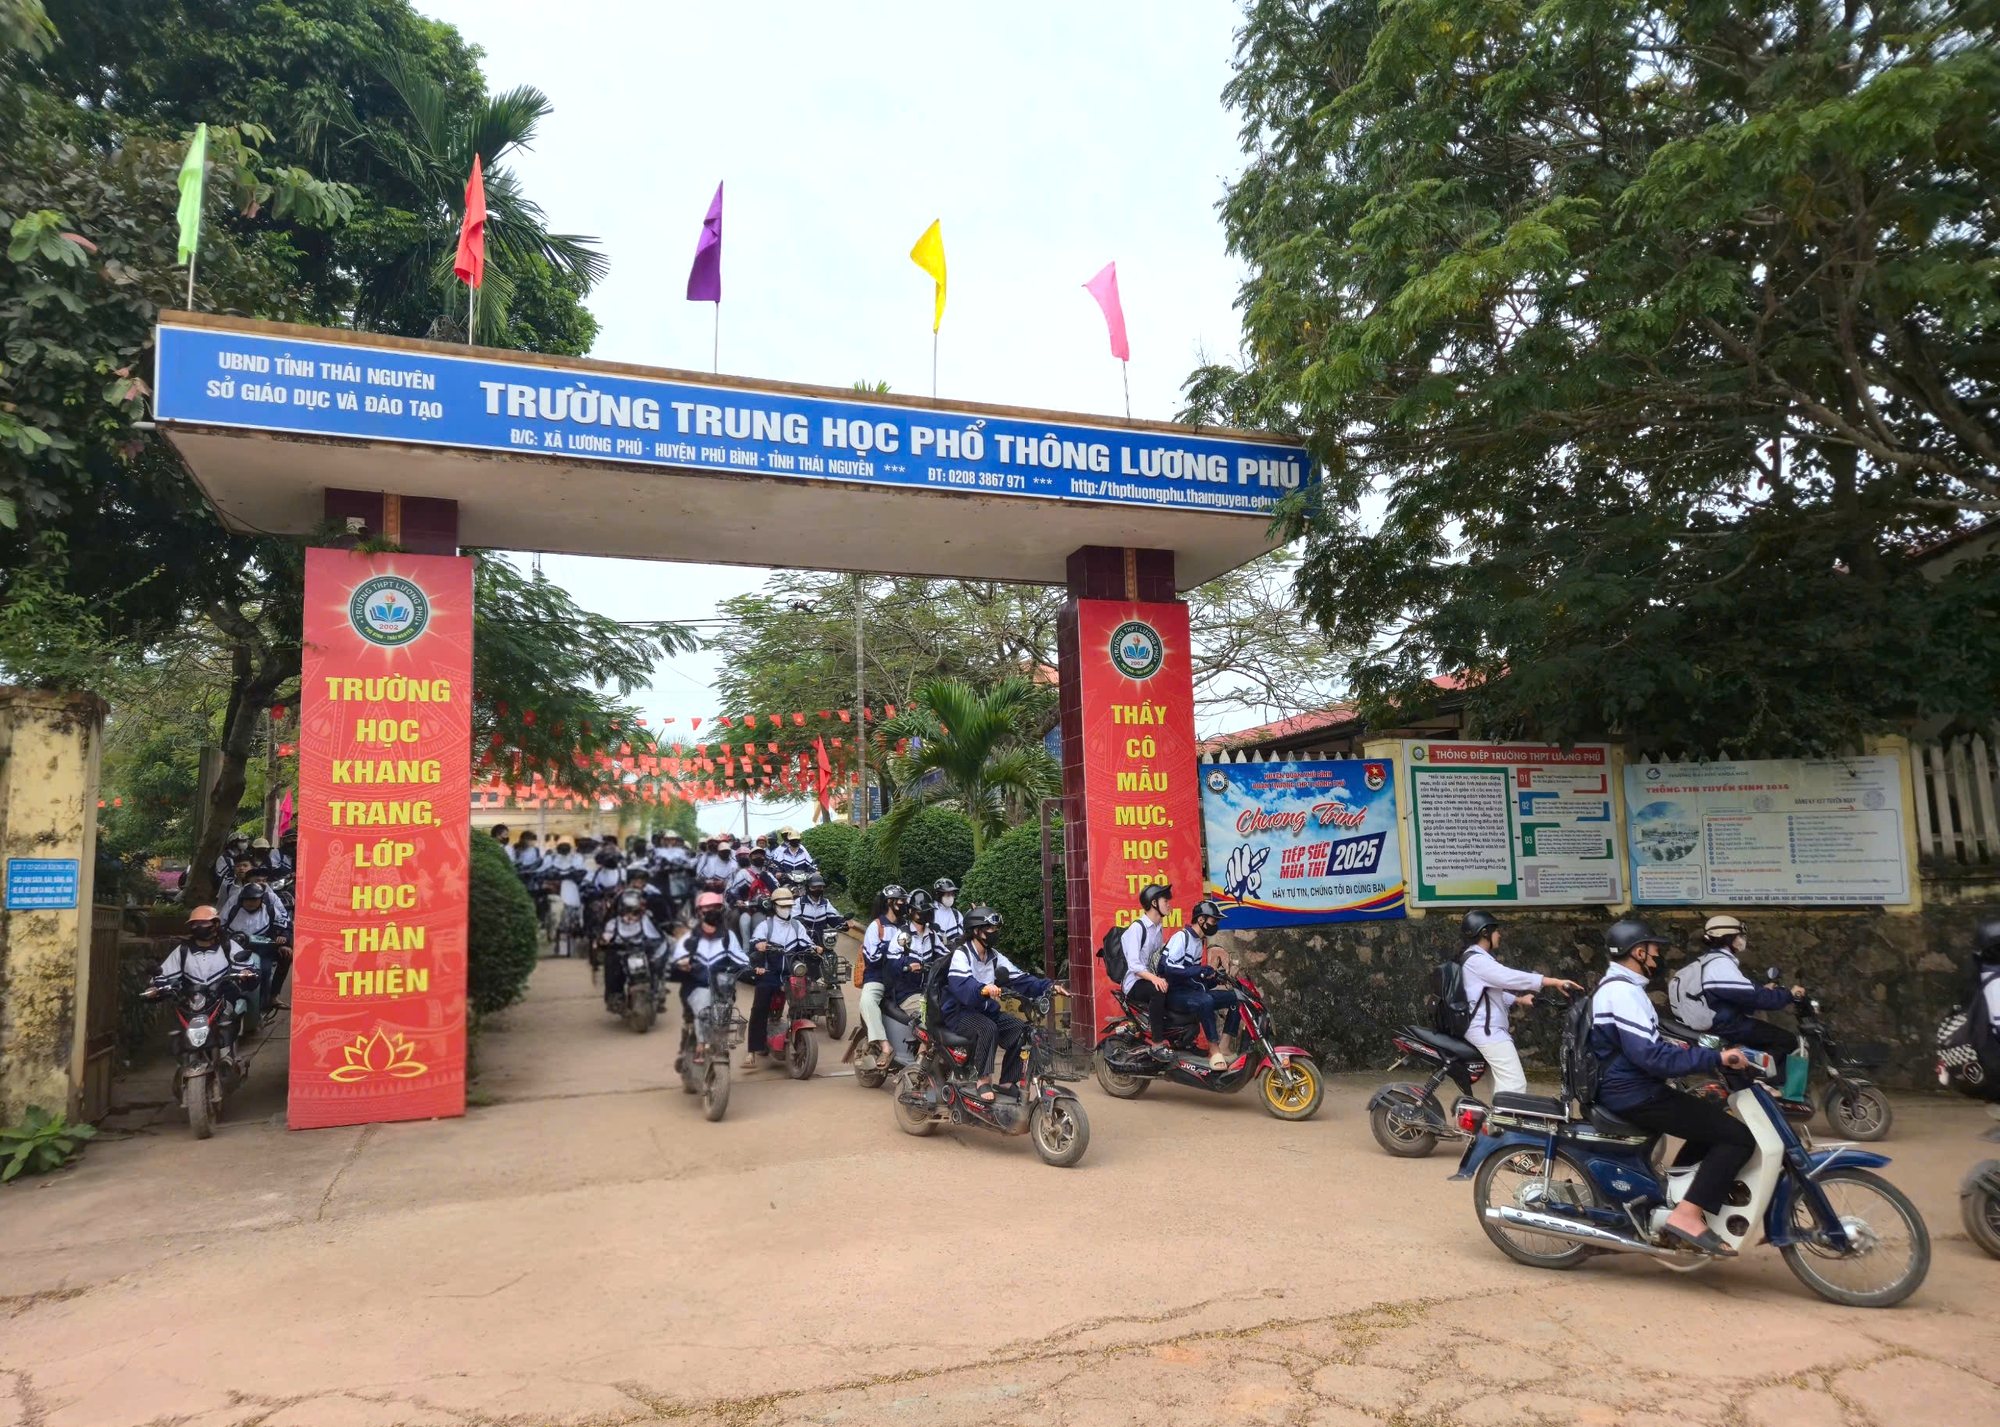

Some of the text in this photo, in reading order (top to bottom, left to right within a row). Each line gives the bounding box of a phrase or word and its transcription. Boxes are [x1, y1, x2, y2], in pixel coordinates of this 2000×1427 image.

[219, 351, 435, 391] UBND TỈNH THÁI NGUYÊN
[206, 375, 443, 421] SỞ GIÁO DỤC VÀ ĐÀO TẠO
[479, 380, 1299, 488] TRƯỜNG TRUNG HỌC PHỔ THÔNG LƯƠNG PHÚ
[509, 429, 1280, 510] Đ/C: XÃ LƯƠNG PHÚ HUYỆN PHÚ BÌNH TỈNH THÁI NGUYÊN ĐT: 0208 3867 971 http://thptluongphu.thainguyen.edu.v
[355, 581, 424, 622] TRƯỜNG THPT LƯƠNG PHÚ
[379, 623, 399, 631] 2002
[325, 673, 451, 703] TRƯỜNG
[1111, 699, 1167, 725] THẦY
[356, 719, 419, 748] HỌC
[1126, 735, 1156, 758] CÔ
[1436, 748, 1468, 760] THÔNG
[1470, 749, 1489, 762] ĐIỆP
[1491, 750, 1527, 761] TRƯỜNG
[1529, 752, 1549, 761] THPT
[1584, 751, 1601, 761] PHÚ
[332, 760, 441, 783] KHANG
[1116, 765, 1168, 792] MẪU
[1520, 775, 1527, 783] 01
[1645, 784, 1681, 793] THÔNG
[1702, 782, 1736, 792] TUYỂN
[329, 801, 441, 827] TRANG,
[1115, 804, 1174, 830] MỰC,
[1312, 802, 1368, 828] Trình
[1522, 801, 1529, 810] 02
[354, 838, 415, 868] LỚP
[1123, 840, 1169, 864] HỌC
[1281, 840, 1331, 864] TIẾP SỨC
[1525, 836, 1532, 844] 03
[1332, 838, 1380, 871] 2025
[1280, 860, 1327, 879] MÙA THI
[351, 884, 416, 915] HỌC
[1272, 883, 1386, 900] HÃY TỰ TIN, CHÚNG TÔI ĐI CÙNG BẠN
[1115, 908, 1182, 928] CHM
[341, 922, 425, 953] THÂN
[335, 964, 428, 999] THIỆN
[1181, 1063, 1196, 1071] JVC
